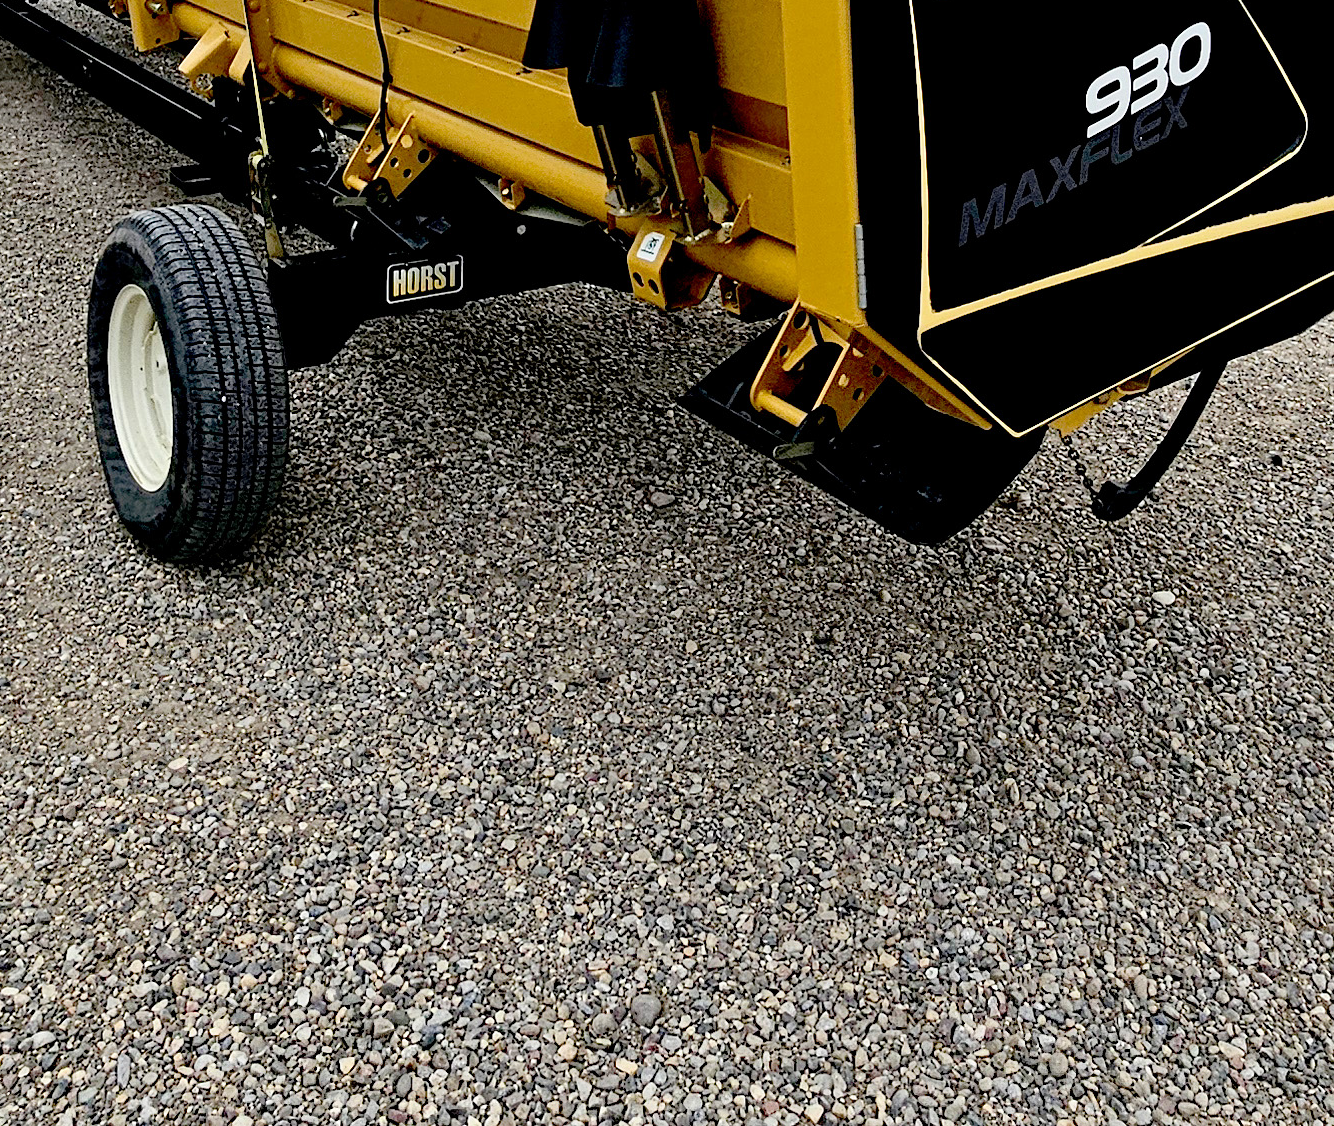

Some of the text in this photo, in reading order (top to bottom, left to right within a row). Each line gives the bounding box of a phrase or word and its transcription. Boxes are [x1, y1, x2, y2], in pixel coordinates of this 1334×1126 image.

[1085, 21, 1211, 139] 930
[958, 85, 1191, 248] MAXFLEX
[392, 260, 460, 298] HORST
